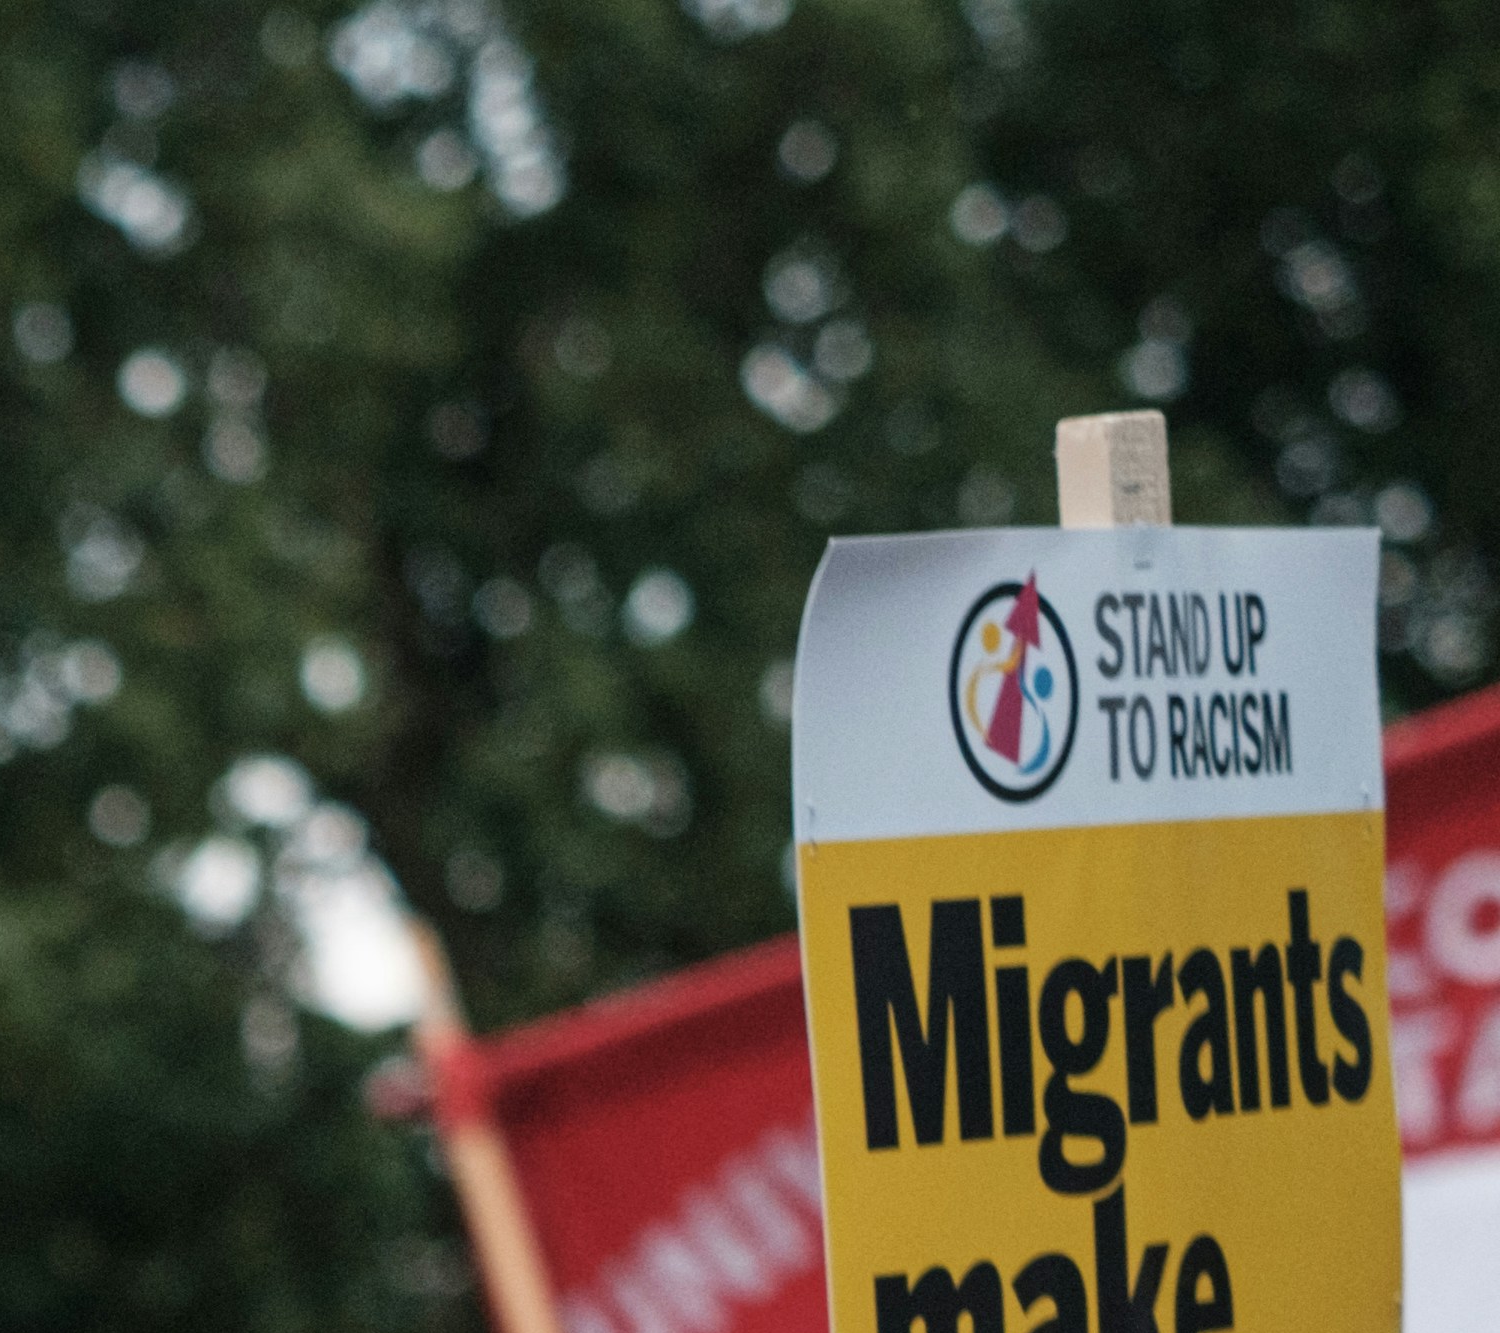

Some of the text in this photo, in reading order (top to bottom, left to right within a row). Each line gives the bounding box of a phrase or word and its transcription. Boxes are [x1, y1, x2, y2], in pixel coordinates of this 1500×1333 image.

[1093, 591, 1267, 678] STAND UP
[1098, 691, 1293, 783] TO RACISM
[847, 887, 1374, 1197] Migrants
